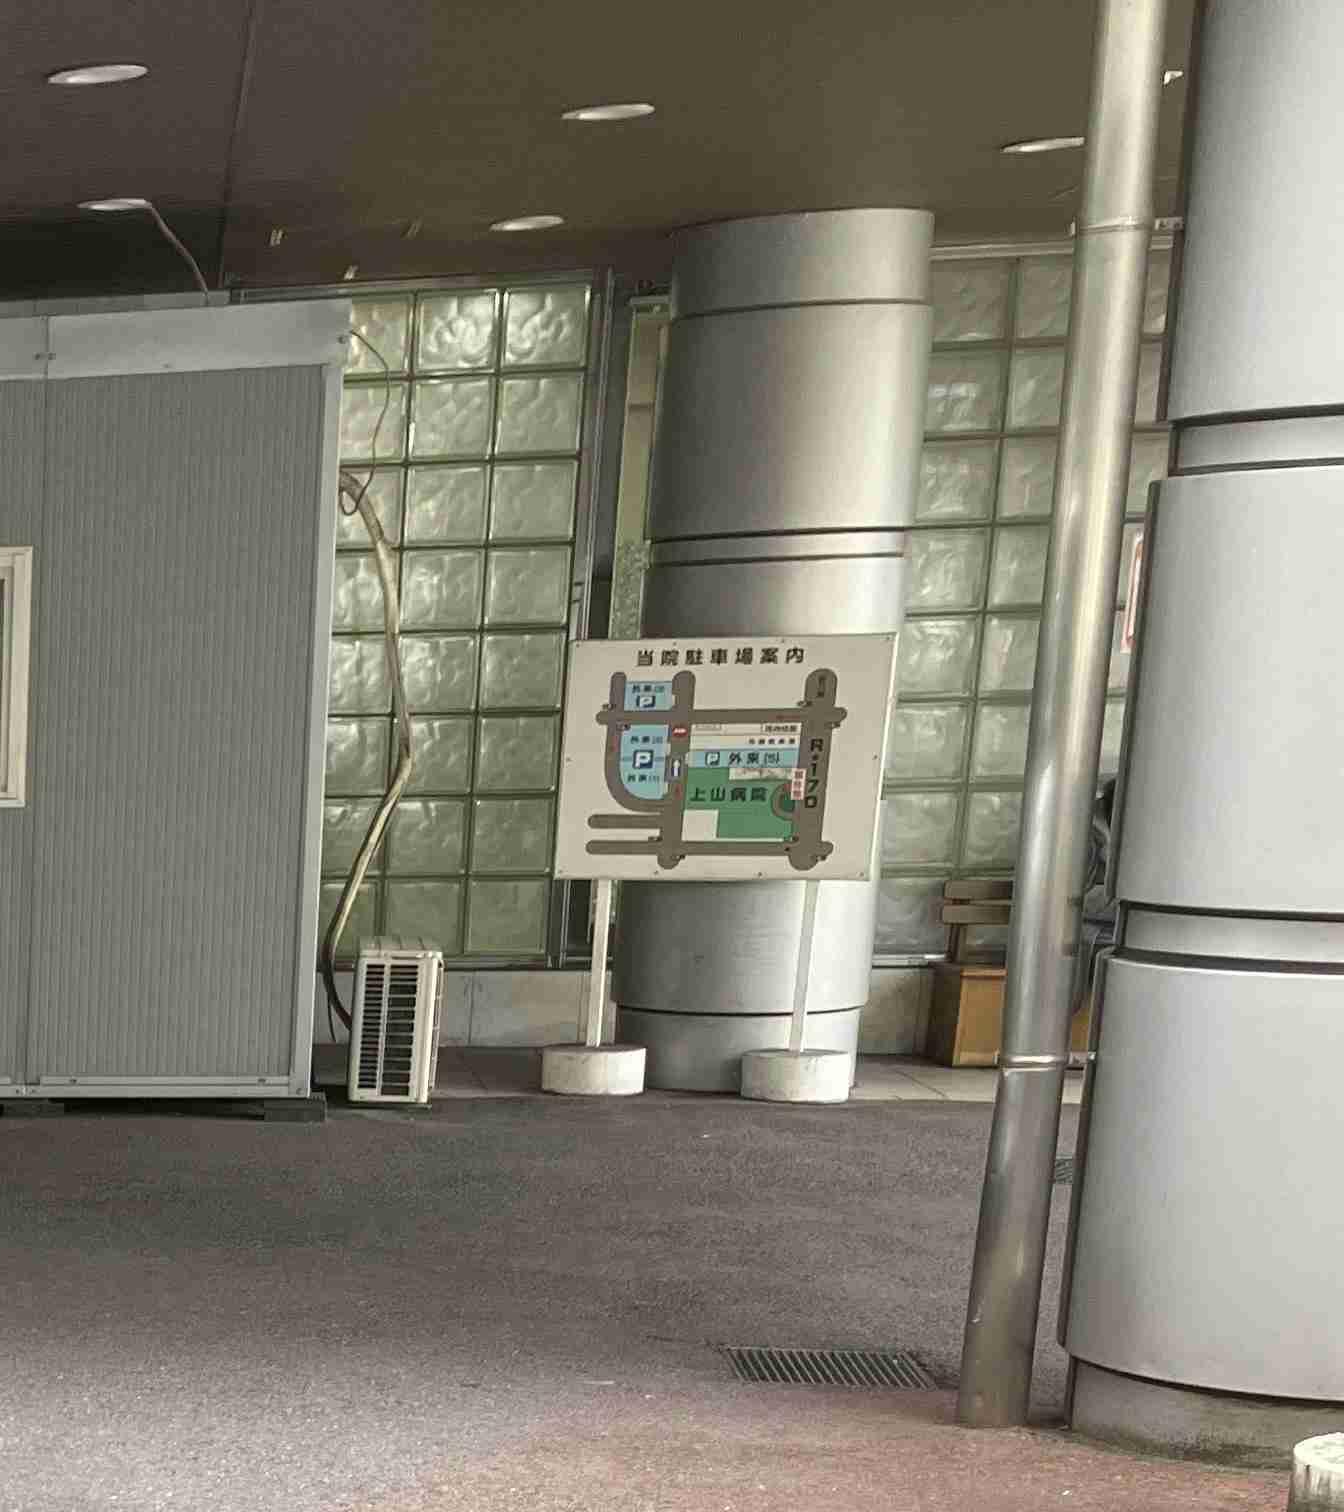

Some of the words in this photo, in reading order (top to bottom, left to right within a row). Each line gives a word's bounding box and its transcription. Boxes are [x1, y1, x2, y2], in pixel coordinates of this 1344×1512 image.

[636, 647, 805, 667] 当院駐車場案内
[637, 751, 650, 767] P
[690, 787, 767, 802] 上山病院
